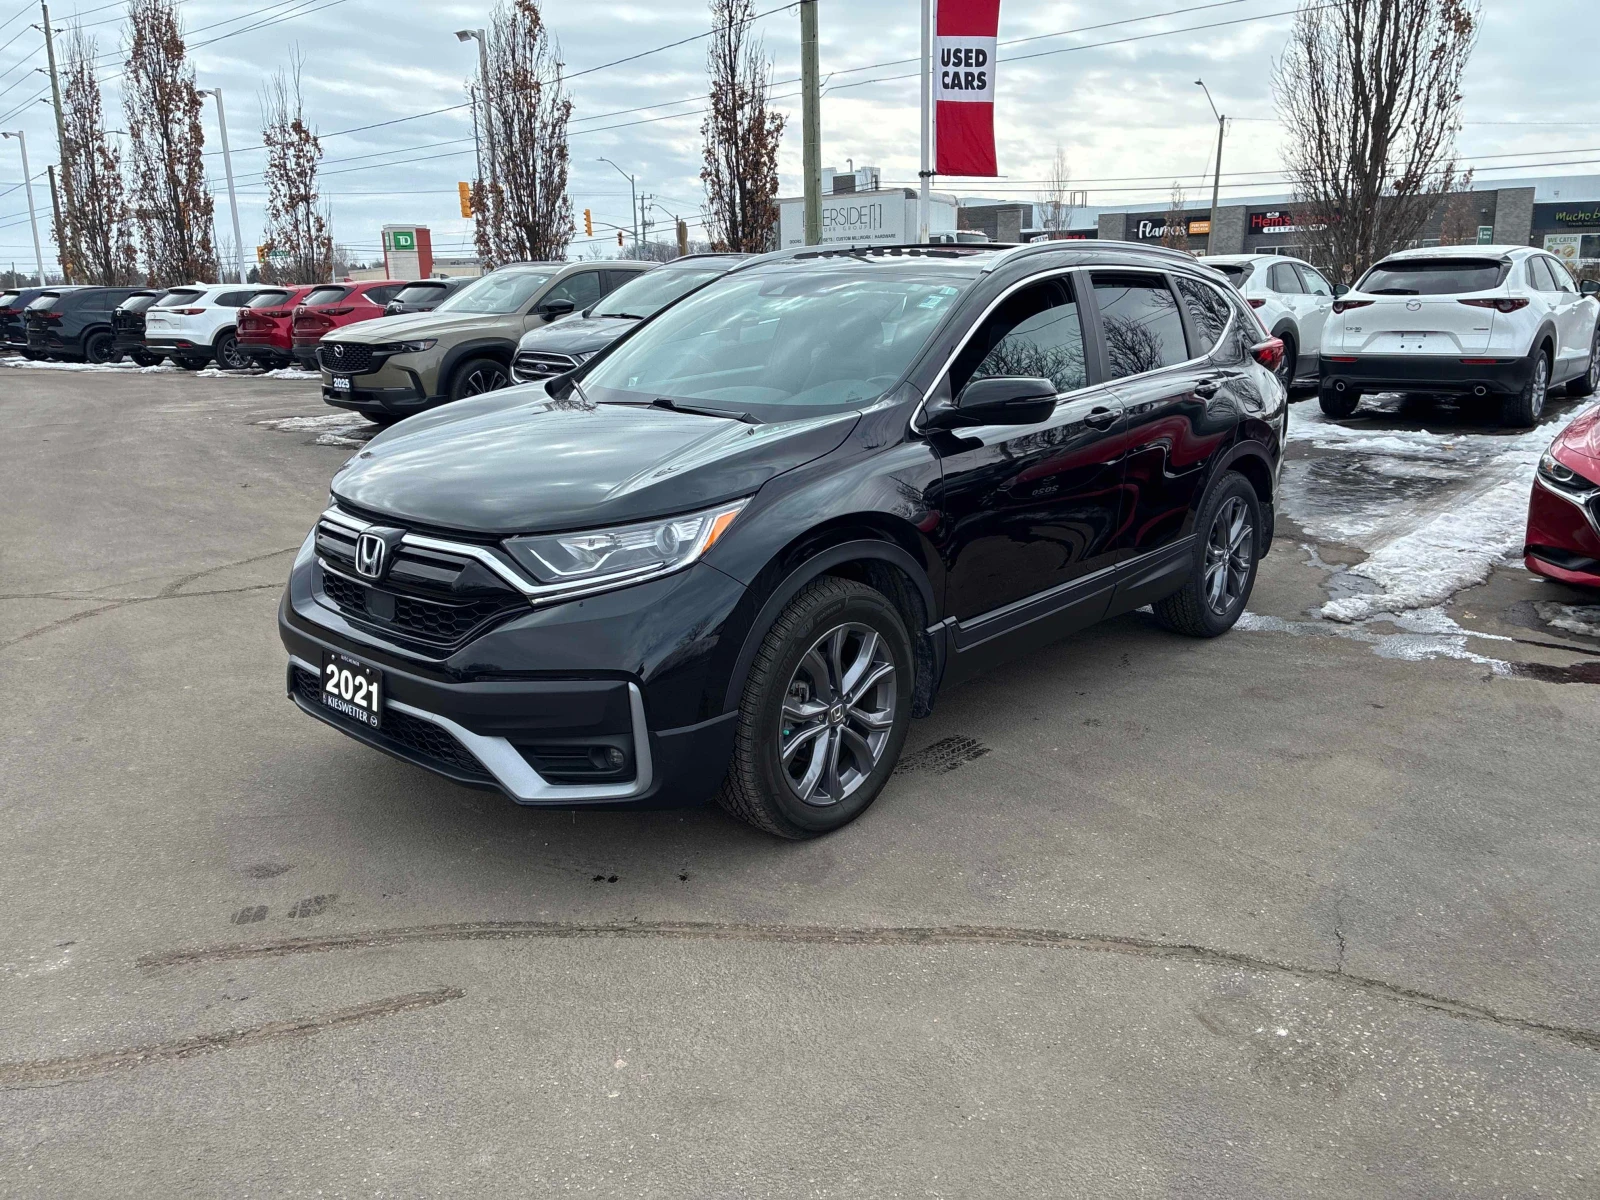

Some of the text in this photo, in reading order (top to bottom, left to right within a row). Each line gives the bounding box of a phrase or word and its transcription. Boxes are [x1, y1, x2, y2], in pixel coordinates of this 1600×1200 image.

[941, 48, 987, 67] USED
[942, 71, 987, 90] CARS
[1252, 215, 1290, 227] Hem's
[1555, 210, 1591, 221] Mucho
[397, 236, 411, 246] TD
[333, 377, 350, 389] 2025
[325, 664, 378, 712] 2021
[327, 695, 368, 723] KIESWETTER
